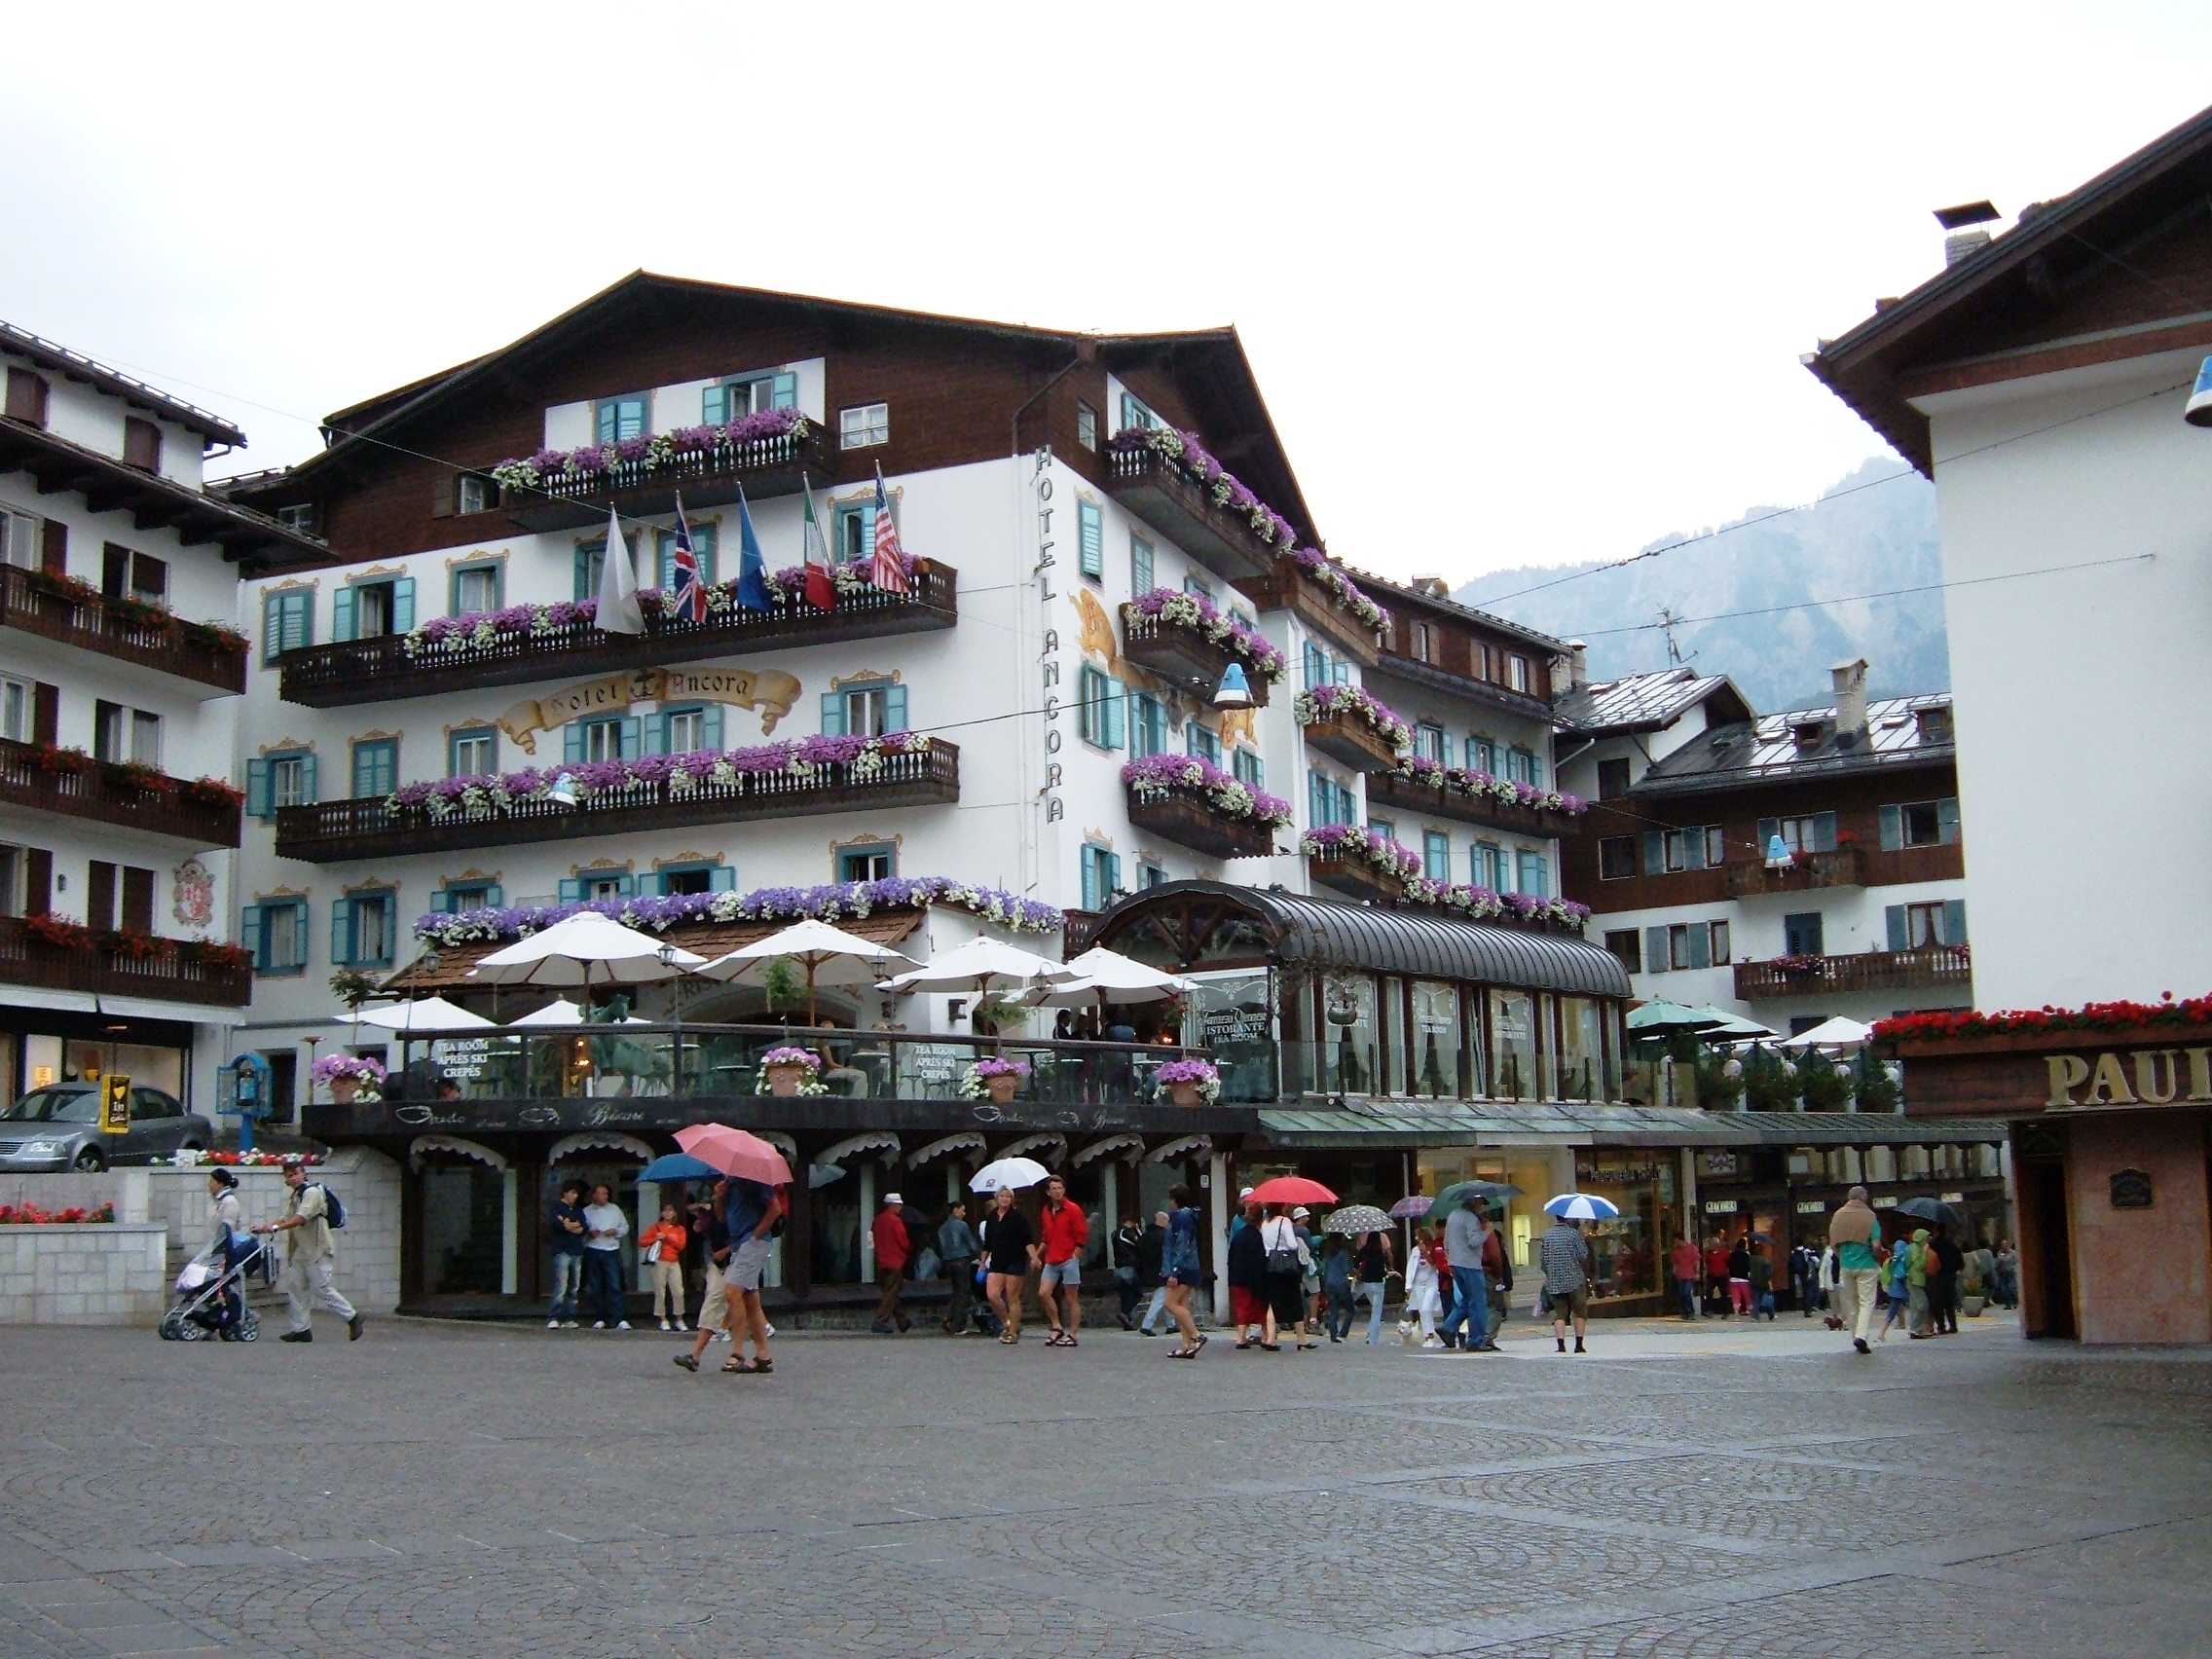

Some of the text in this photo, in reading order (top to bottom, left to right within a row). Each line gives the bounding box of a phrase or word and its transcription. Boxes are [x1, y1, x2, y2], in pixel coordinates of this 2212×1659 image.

[1035, 443, 1064, 826] HOTEL ANCORA
[672, 673, 748, 695] Ancora
[438, 1040, 489, 1051] TEA ROOM
